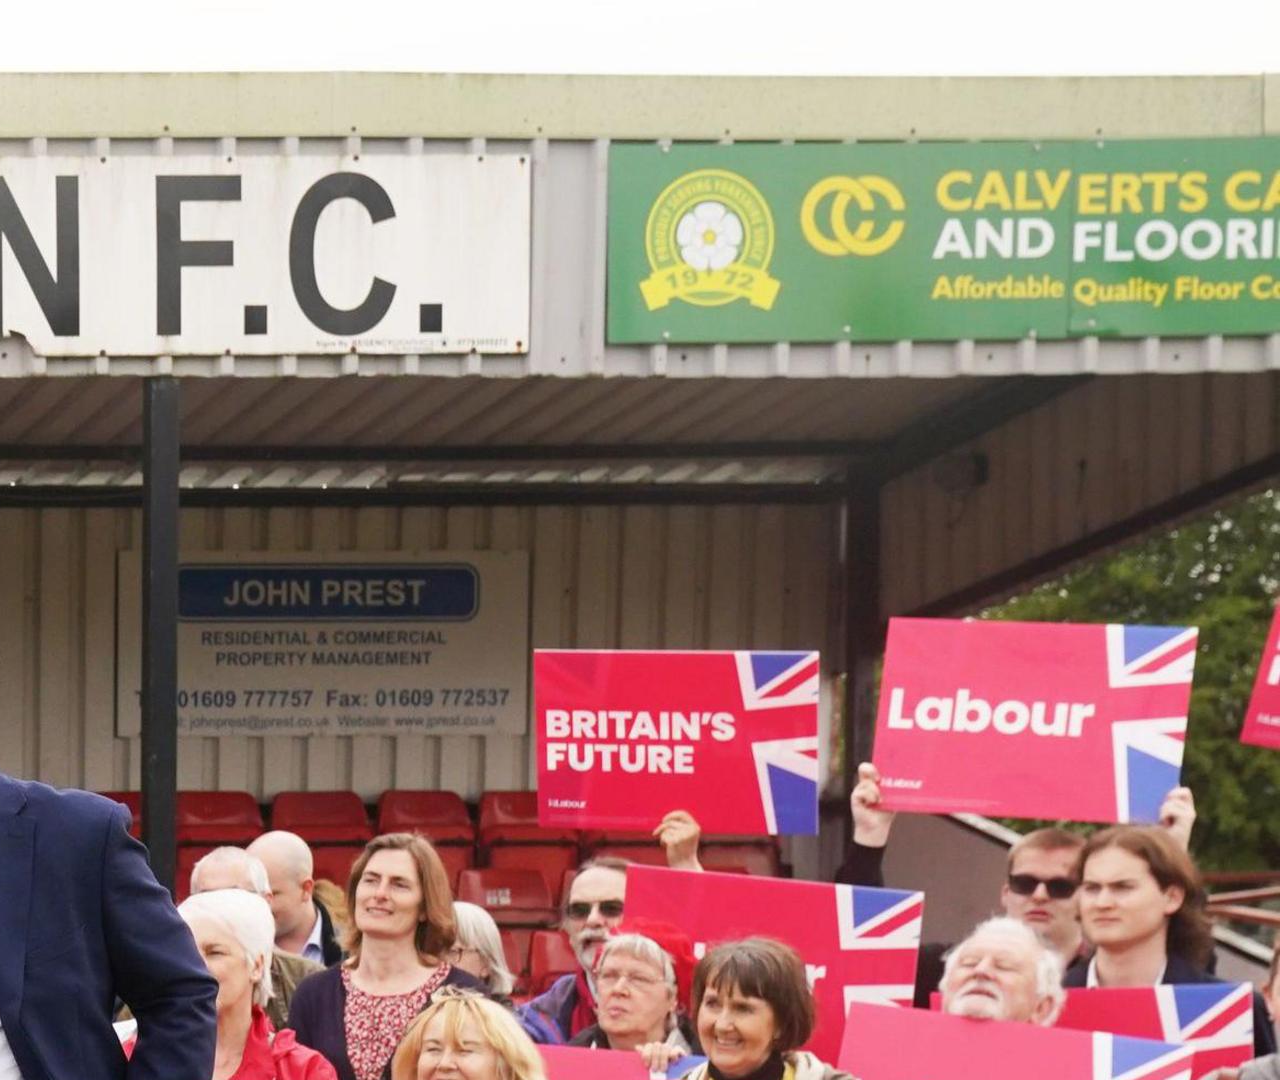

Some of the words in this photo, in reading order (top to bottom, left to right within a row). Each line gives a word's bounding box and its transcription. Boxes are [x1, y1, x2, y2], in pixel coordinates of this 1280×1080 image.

[935, 169, 1209, 215] CALVERTS
[155, 172, 442, 335] F.C.
[931, 217, 1056, 260] AND
[1072, 217, 1280, 263] FLOORI
[931, 274, 1065, 300] Affordable
[1073, 277, 1169, 308] Quality
[1174, 276, 1244, 300] Floor
[223, 578, 311, 607] JOHN
[321, 578, 427, 607] PREST
[201, 630, 312, 646] RESIDENTIAL
[318, 631, 328, 645] &
[334, 630, 447, 646] COMMERCIAL
[215, 651, 307, 667] PROPERTY
[312, 650, 432, 667] MANAGEMENT
[178, 689, 237, 709] 01609
[243, 689, 314, 709] 777757
[326, 689, 368, 709] Fax:
[376, 688, 434, 708] 01609
[442, 688, 510, 708] 772537
[887, 686, 1097, 738] Labour
[545, 709, 737, 742] BRITAIN'S
[546, 742, 695, 774] FUTURE
